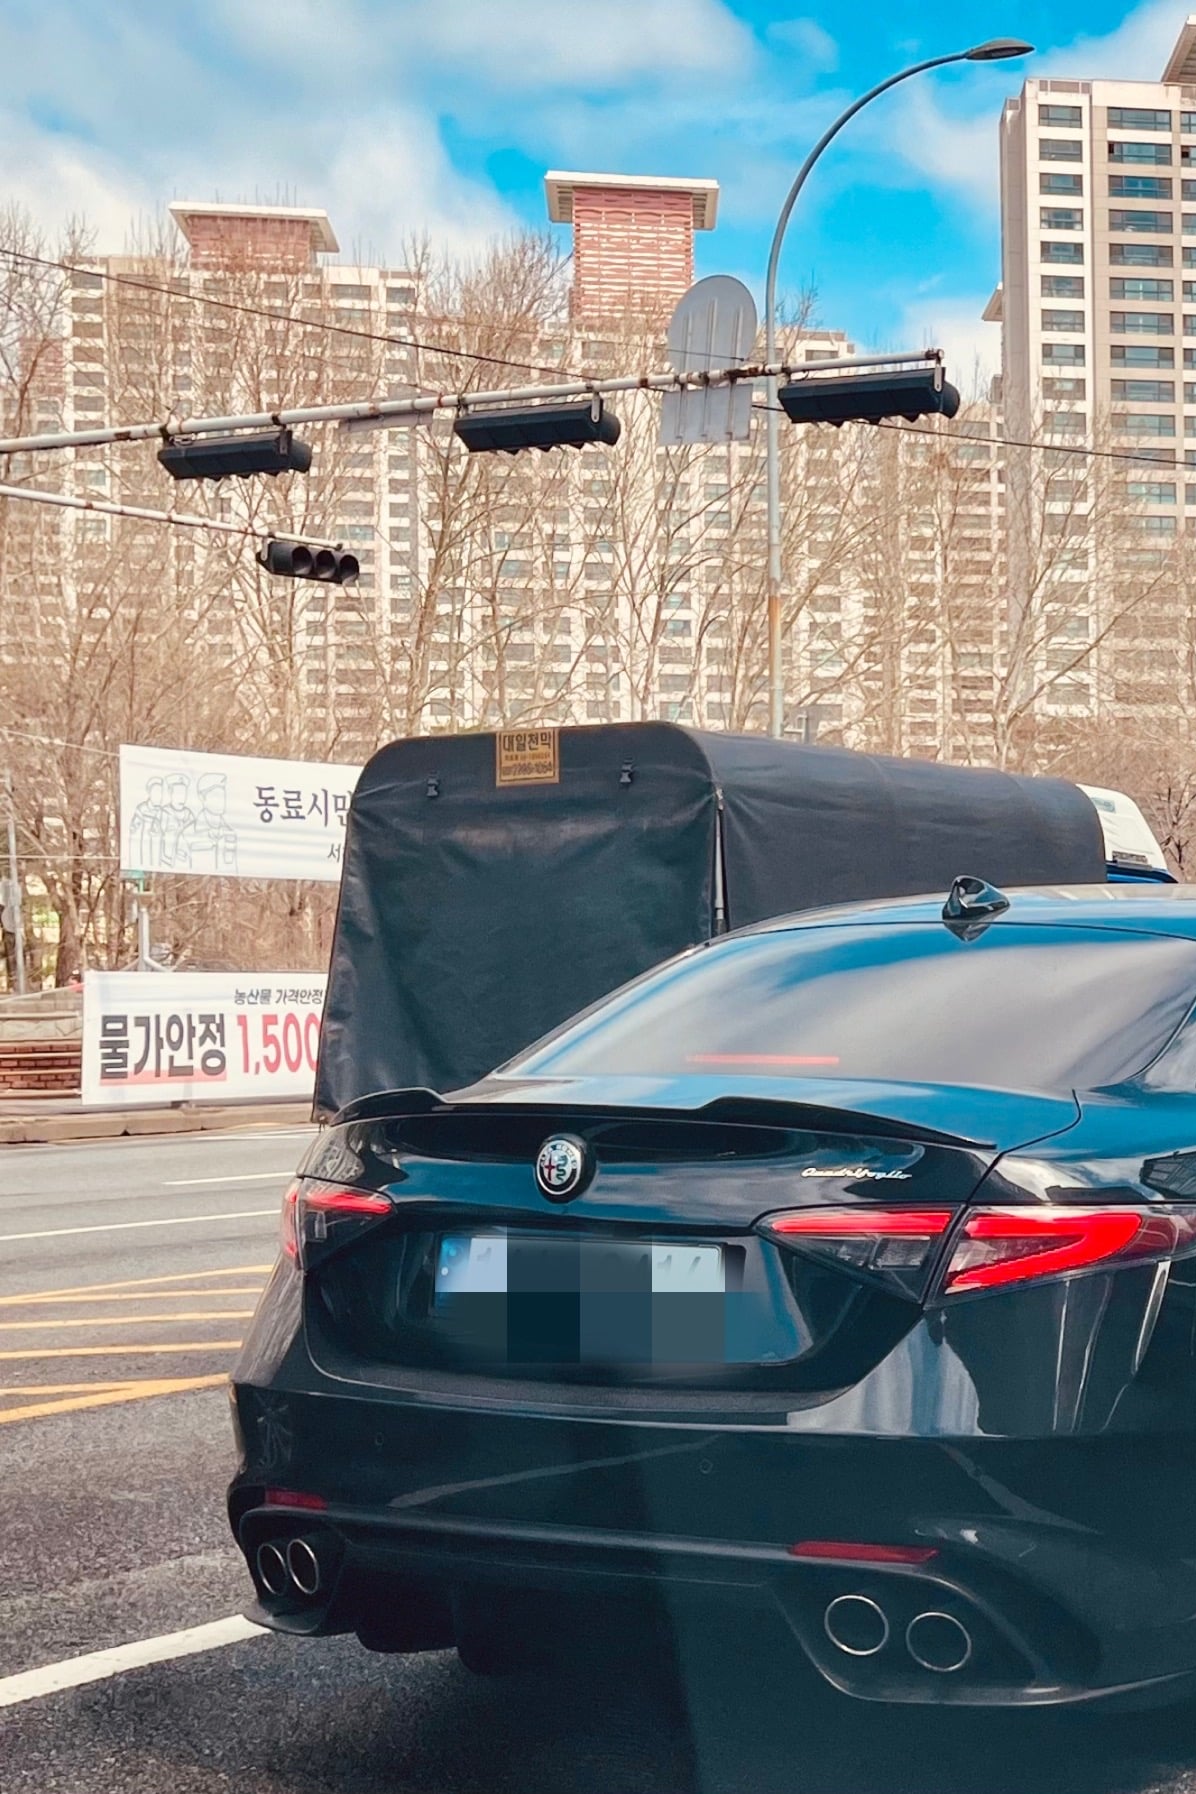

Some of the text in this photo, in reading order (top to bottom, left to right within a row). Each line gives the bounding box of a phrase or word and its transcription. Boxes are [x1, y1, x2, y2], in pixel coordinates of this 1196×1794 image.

[234, 988, 272, 1005] 농산물
[99, 1012, 322, 1079] 물가안정 1,500
